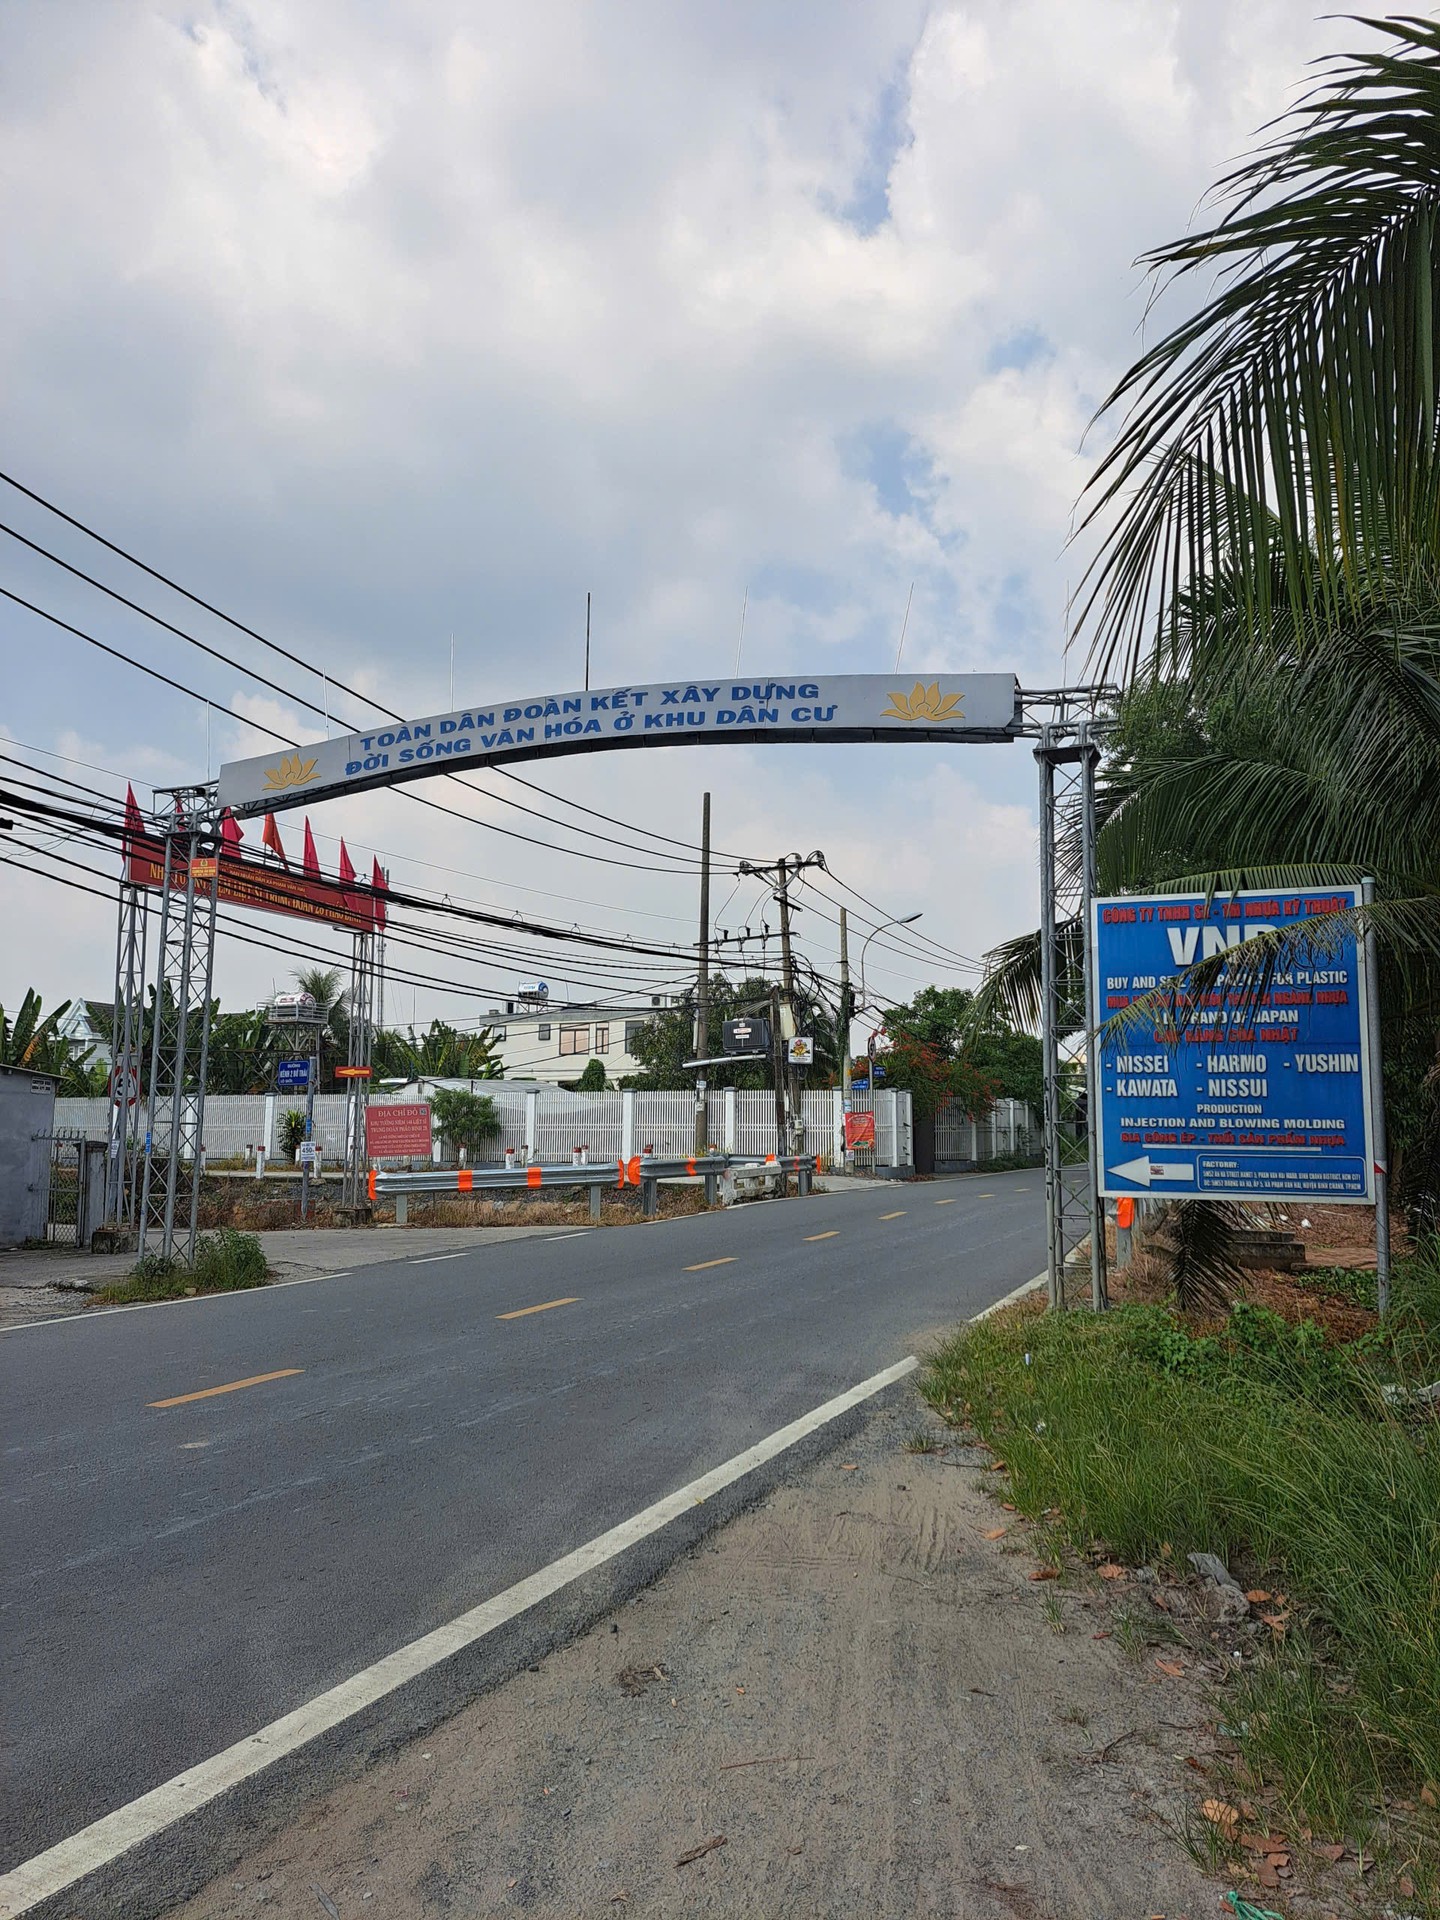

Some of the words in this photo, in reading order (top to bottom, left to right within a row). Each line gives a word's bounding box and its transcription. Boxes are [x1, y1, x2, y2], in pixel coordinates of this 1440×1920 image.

[361, 724, 430, 750] TOÀN
[440, 713, 495, 735] DÂN
[503, 697, 582, 722] ĐOÀN
[591, 688, 648, 711] KẾT
[661, 685, 721, 706] XÂY
[731, 683, 819, 703] DỰNG
[345, 753, 389, 776] ĐỜI
[399, 739, 471, 763] SỐNG
[480, 725, 534, 748] VĂN
[545, 717, 602, 738] HÓA
[614, 710, 635, 731] Ở
[644, 711, 706, 729] KHU
[716, 705, 779, 724] DÂN
[791, 704, 838, 722] CƯ
[1103, 907, 1136, 924] CÔNG
[1140, 907, 1153, 922] TY
[1158, 905, 1190, 921] TNHH
[1245, 900, 1280, 919] NHỰA
[1107, 977, 1129, 989] BUY
[1132, 976, 1156, 989] AND
[1272, 972, 1293, 985] FOR
[1297, 971, 1348, 984] PLASTIC
[1274, 989, 1313, 1005] NGÀNH
[1316, 990, 1348, 1006] NHỰA
[1232, 1010, 1248, 1023] OF
[1253, 1010, 1298, 1023] JAPAN
[1261, 1026, 1298, 1044] NHẬT
[1116, 1055, 1169, 1073] NISSEI
[1207, 1054, 1267, 1073] HARMO
[1295, 1054, 1359, 1073] YUSHIN
[1116, 1079, 1178, 1097] KAWATA
[1208, 1079, 1268, 1097] NISSUI
[378, 1110, 391, 1118] ĐỊA
[393, 1108, 406, 1116] CHỈ
[407, 1106, 418, 1116] ĐỎ
[1196, 1104, 1262, 1114] PRODUCTION
[1120, 1118, 1186, 1128] INJECTION
[1189, 1118, 1216, 1128] AND
[1219, 1119, 1280, 1129] BLOWING
[1284, 1119, 1345, 1129] MOLDING
[1145, 1131, 1176, 1144] CÔNG
[1181, 1131, 1196, 1144] ÉP
[1309, 1133, 1345, 1147] NHỰA
